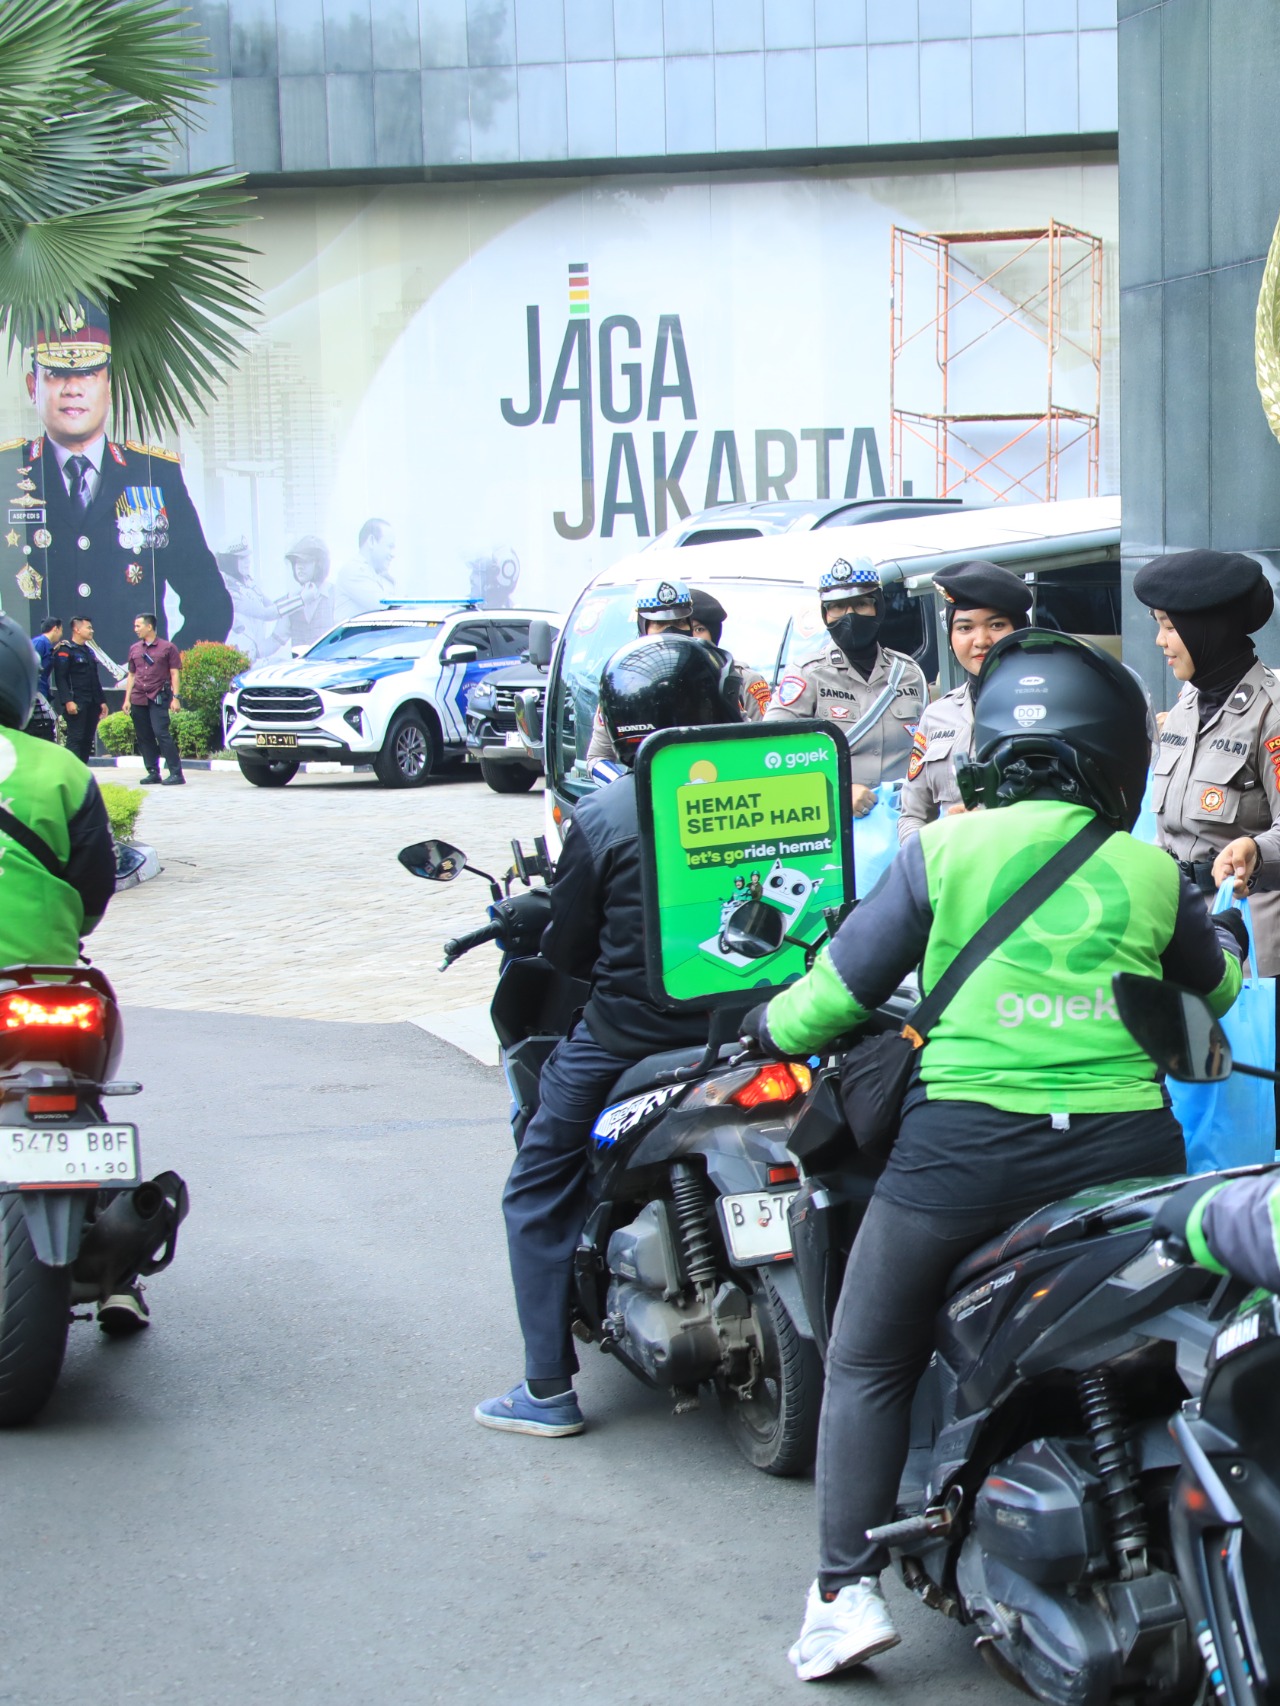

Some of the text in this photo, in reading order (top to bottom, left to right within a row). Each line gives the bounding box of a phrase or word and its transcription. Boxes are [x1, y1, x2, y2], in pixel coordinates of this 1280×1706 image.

[500, 305, 697, 427] JAGA
[553, 427, 886, 540] JAKARTA
[820, 688, 919, 702] SANDRA OLRI
[1018, 708, 1042, 717] DOT
[616, 723, 656, 732] HONDA
[1209, 739, 1248, 755] POLRI
[785, 748, 829, 768] gojek
[686, 793, 762, 815] HEMAT
[687, 806, 821, 834] SETIAP HARI
[779, 838, 832, 855] hemat
[996, 987, 1120, 1028] gojek
[12, 1132, 69, 1152] 5479
[731, 1203, 745, 1226] B
[993, 1270, 1016, 1289] 150
